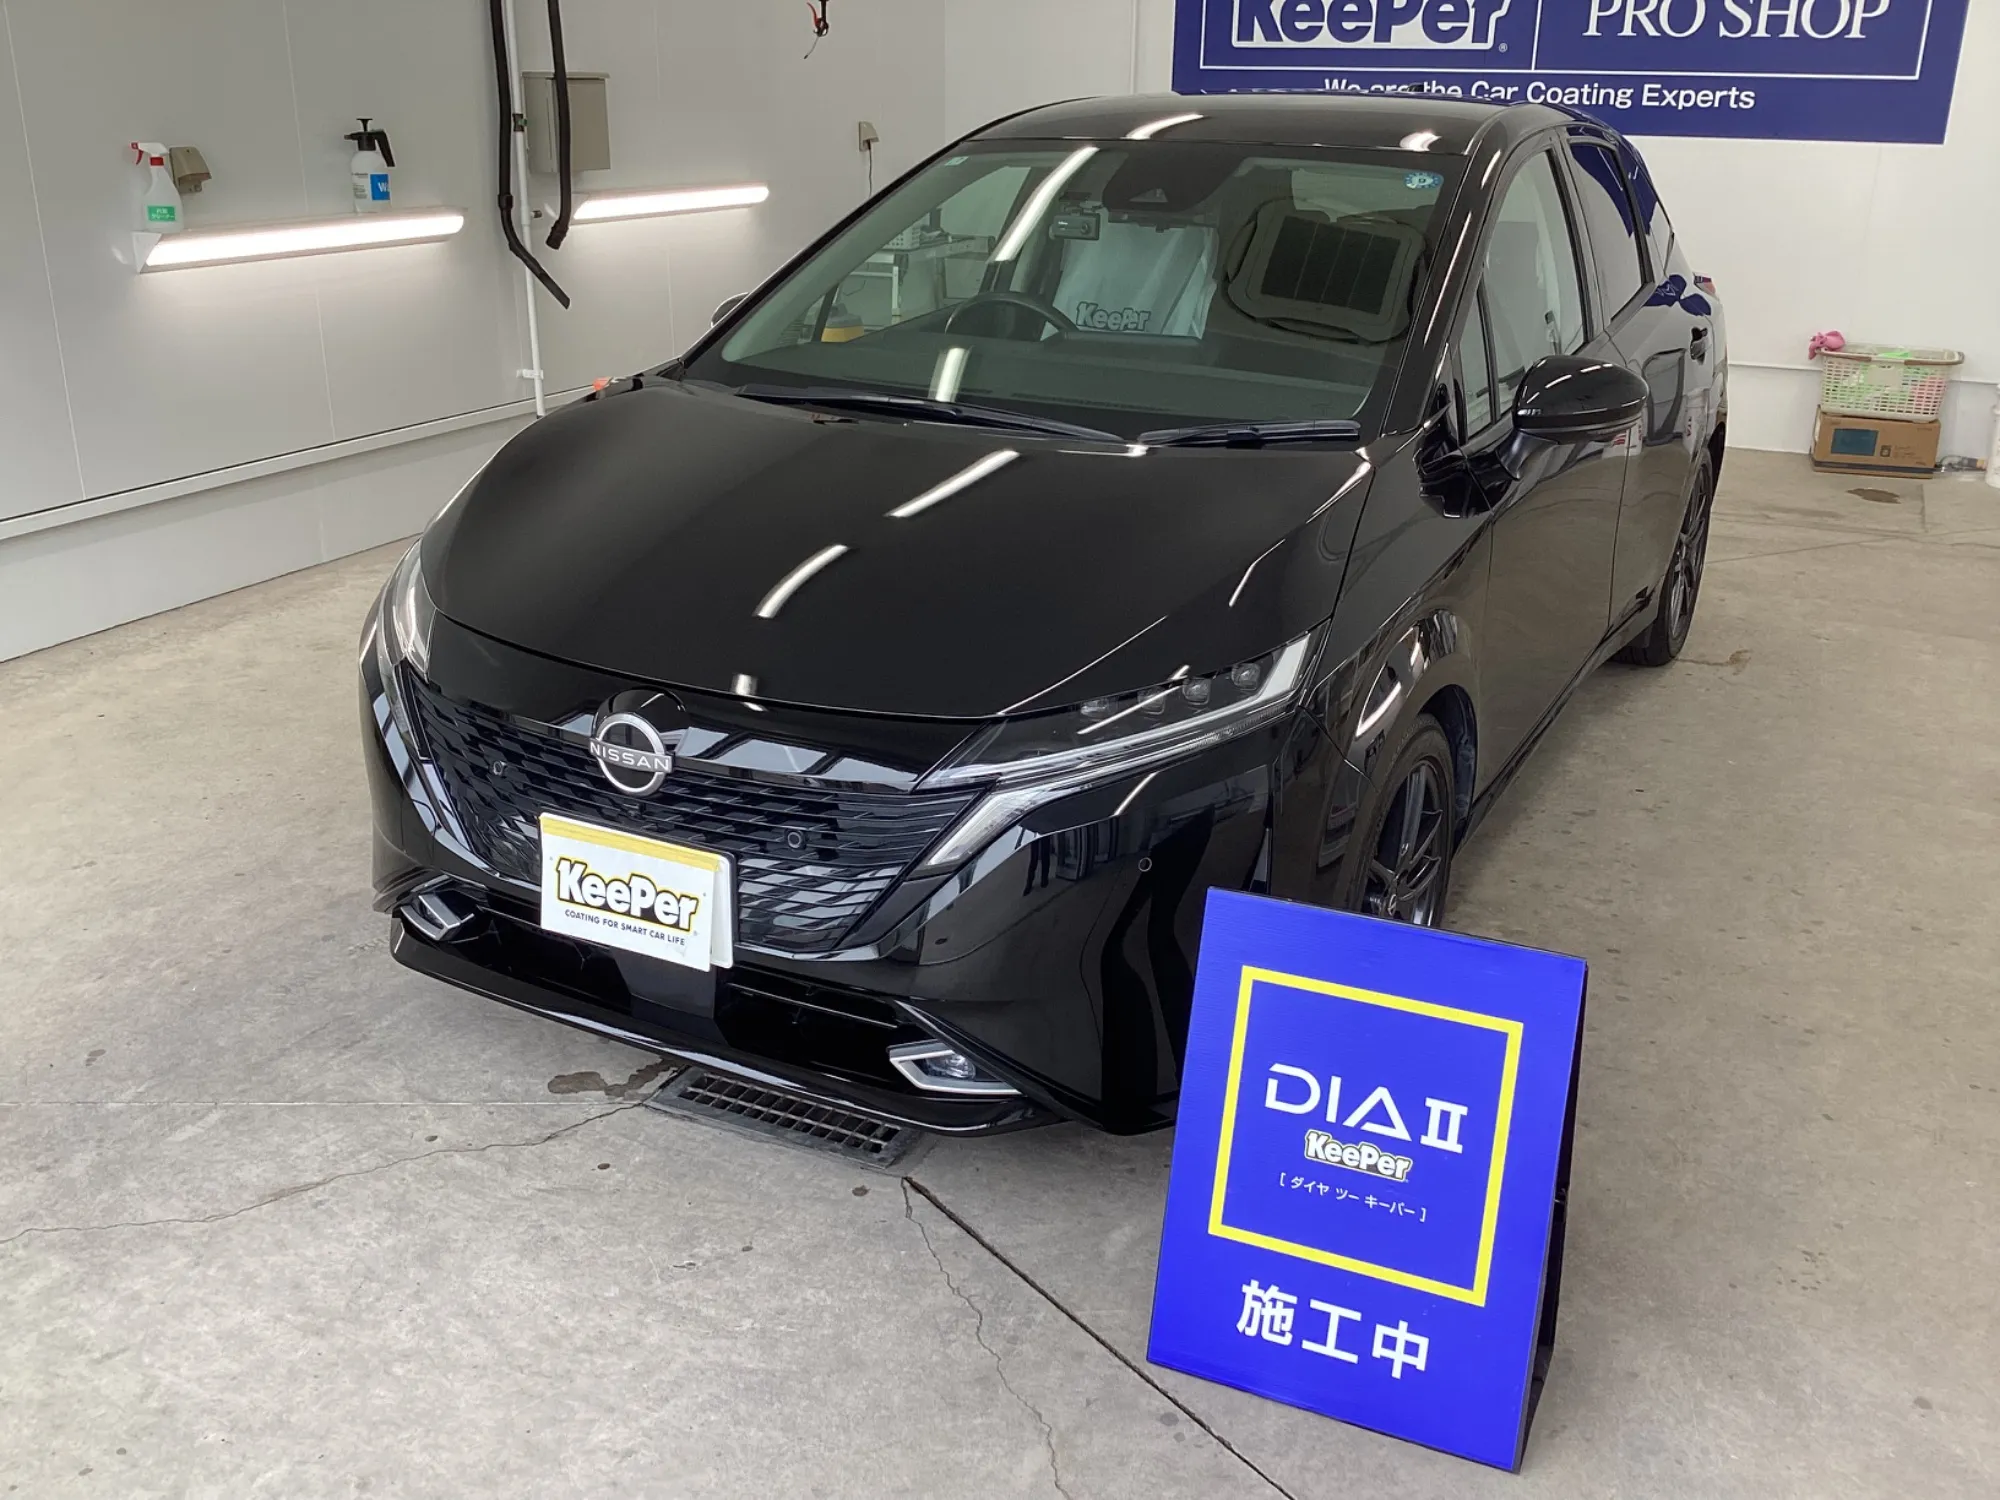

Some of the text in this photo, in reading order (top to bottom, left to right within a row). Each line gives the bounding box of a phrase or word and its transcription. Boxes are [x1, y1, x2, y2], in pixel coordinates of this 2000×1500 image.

[1234, 0, 1504, 45] KeePer
[1582, 0, 1890, 39] PRO SHOP
[1471, 80, 1518, 100] Car
[1527, 81, 1634, 109] Coating
[1642, 84, 1756, 110] Experts
[590, 741, 669, 771] NISSAN
[556, 857, 699, 932] KeePer
[564, 908, 686, 946] COATING FOR SMART CAR LIFE
[1304, 1129, 1413, 1183] KeePer
[1235, 1278, 1430, 1380] 施工中
